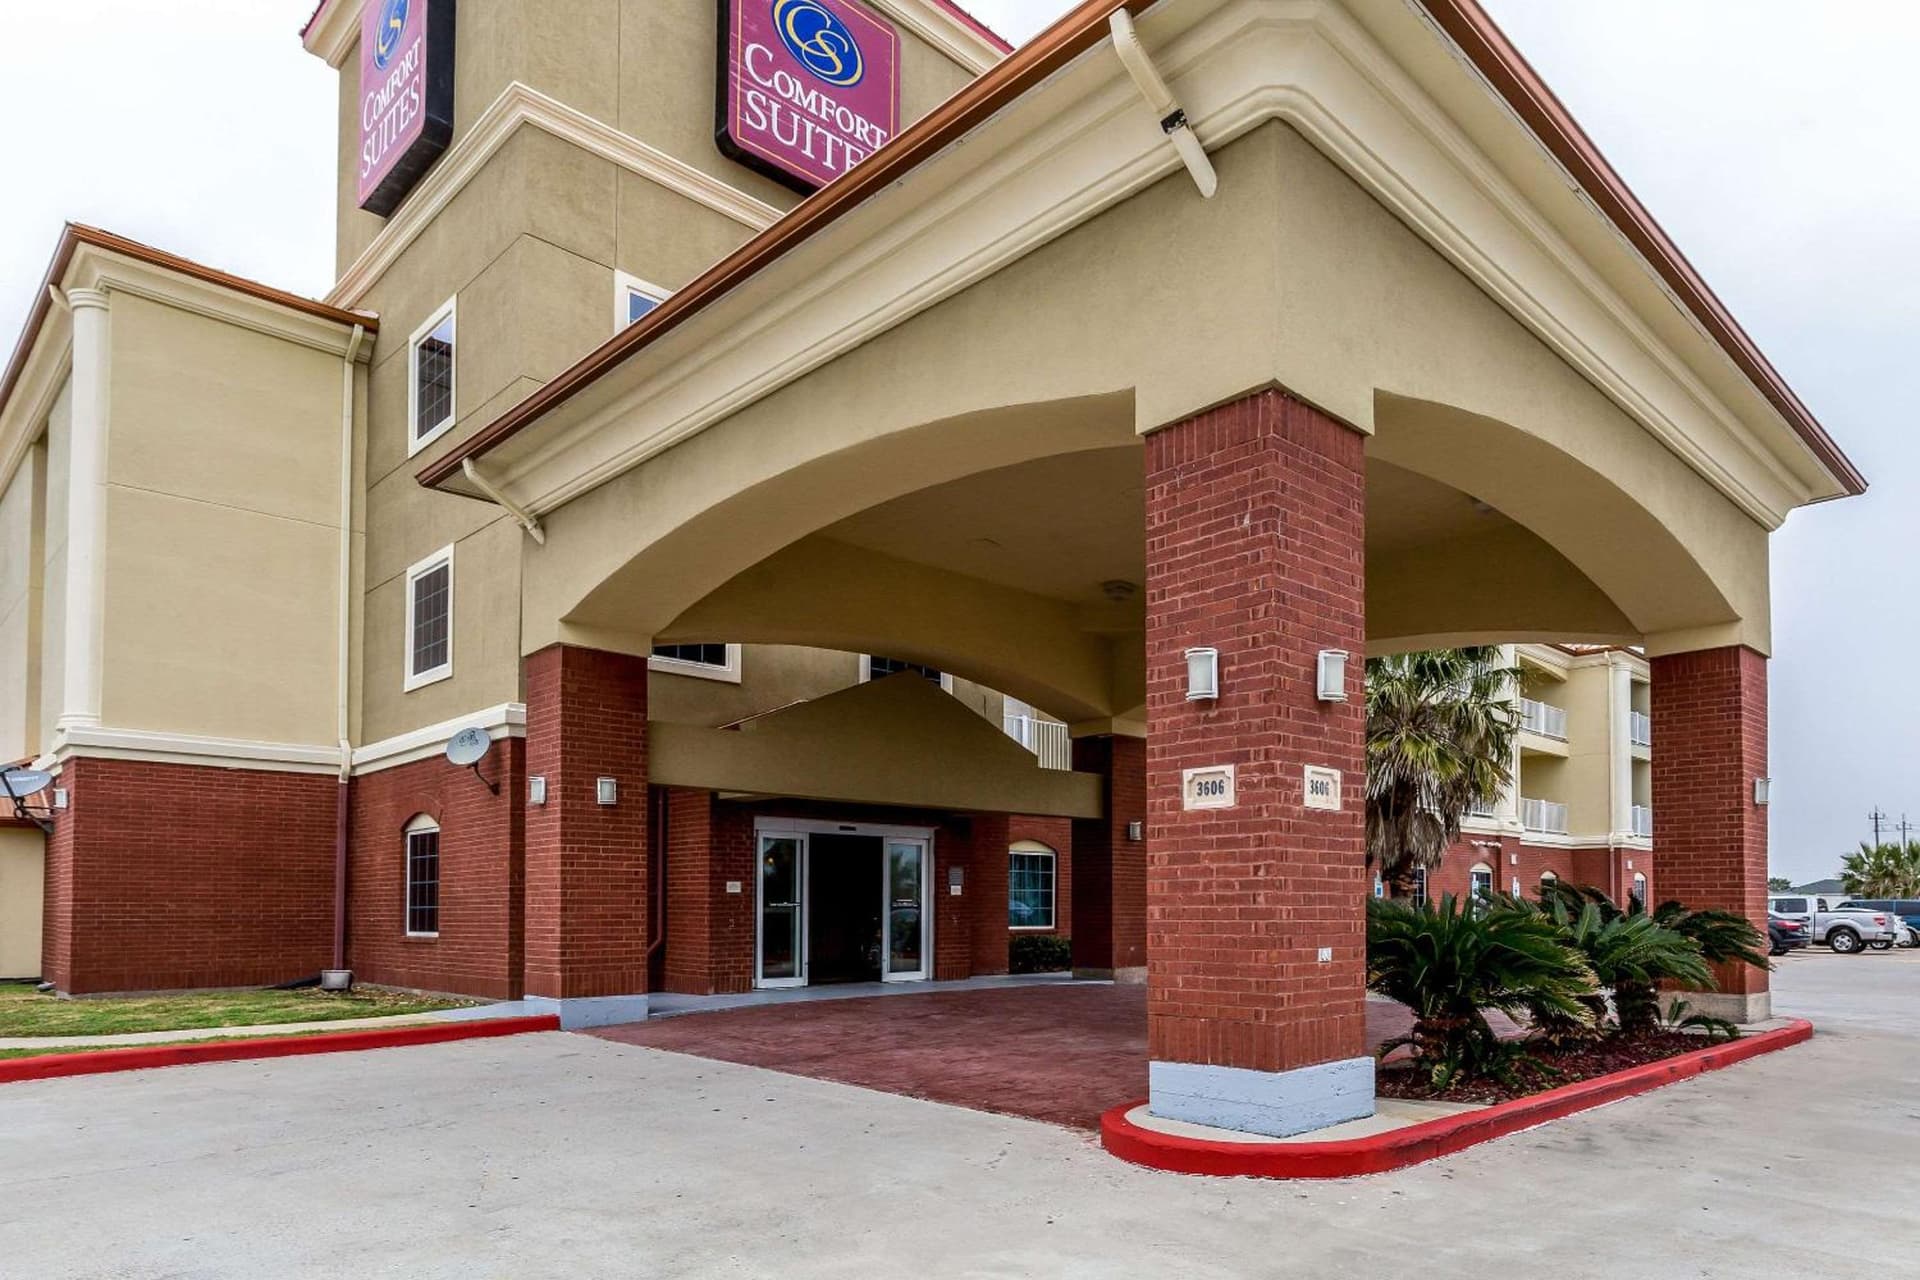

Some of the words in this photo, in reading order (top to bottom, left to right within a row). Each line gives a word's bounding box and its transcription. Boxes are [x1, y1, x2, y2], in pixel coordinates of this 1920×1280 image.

[362, 75, 420, 179] SUITES
[363, 36, 420, 131] COMFORT
[745, 42, 887, 150] COMFORT
[745, 90, 865, 173] SUITE
[1196, 779, 1225, 797] 3606
[1309, 779, 1330, 796] 3606
